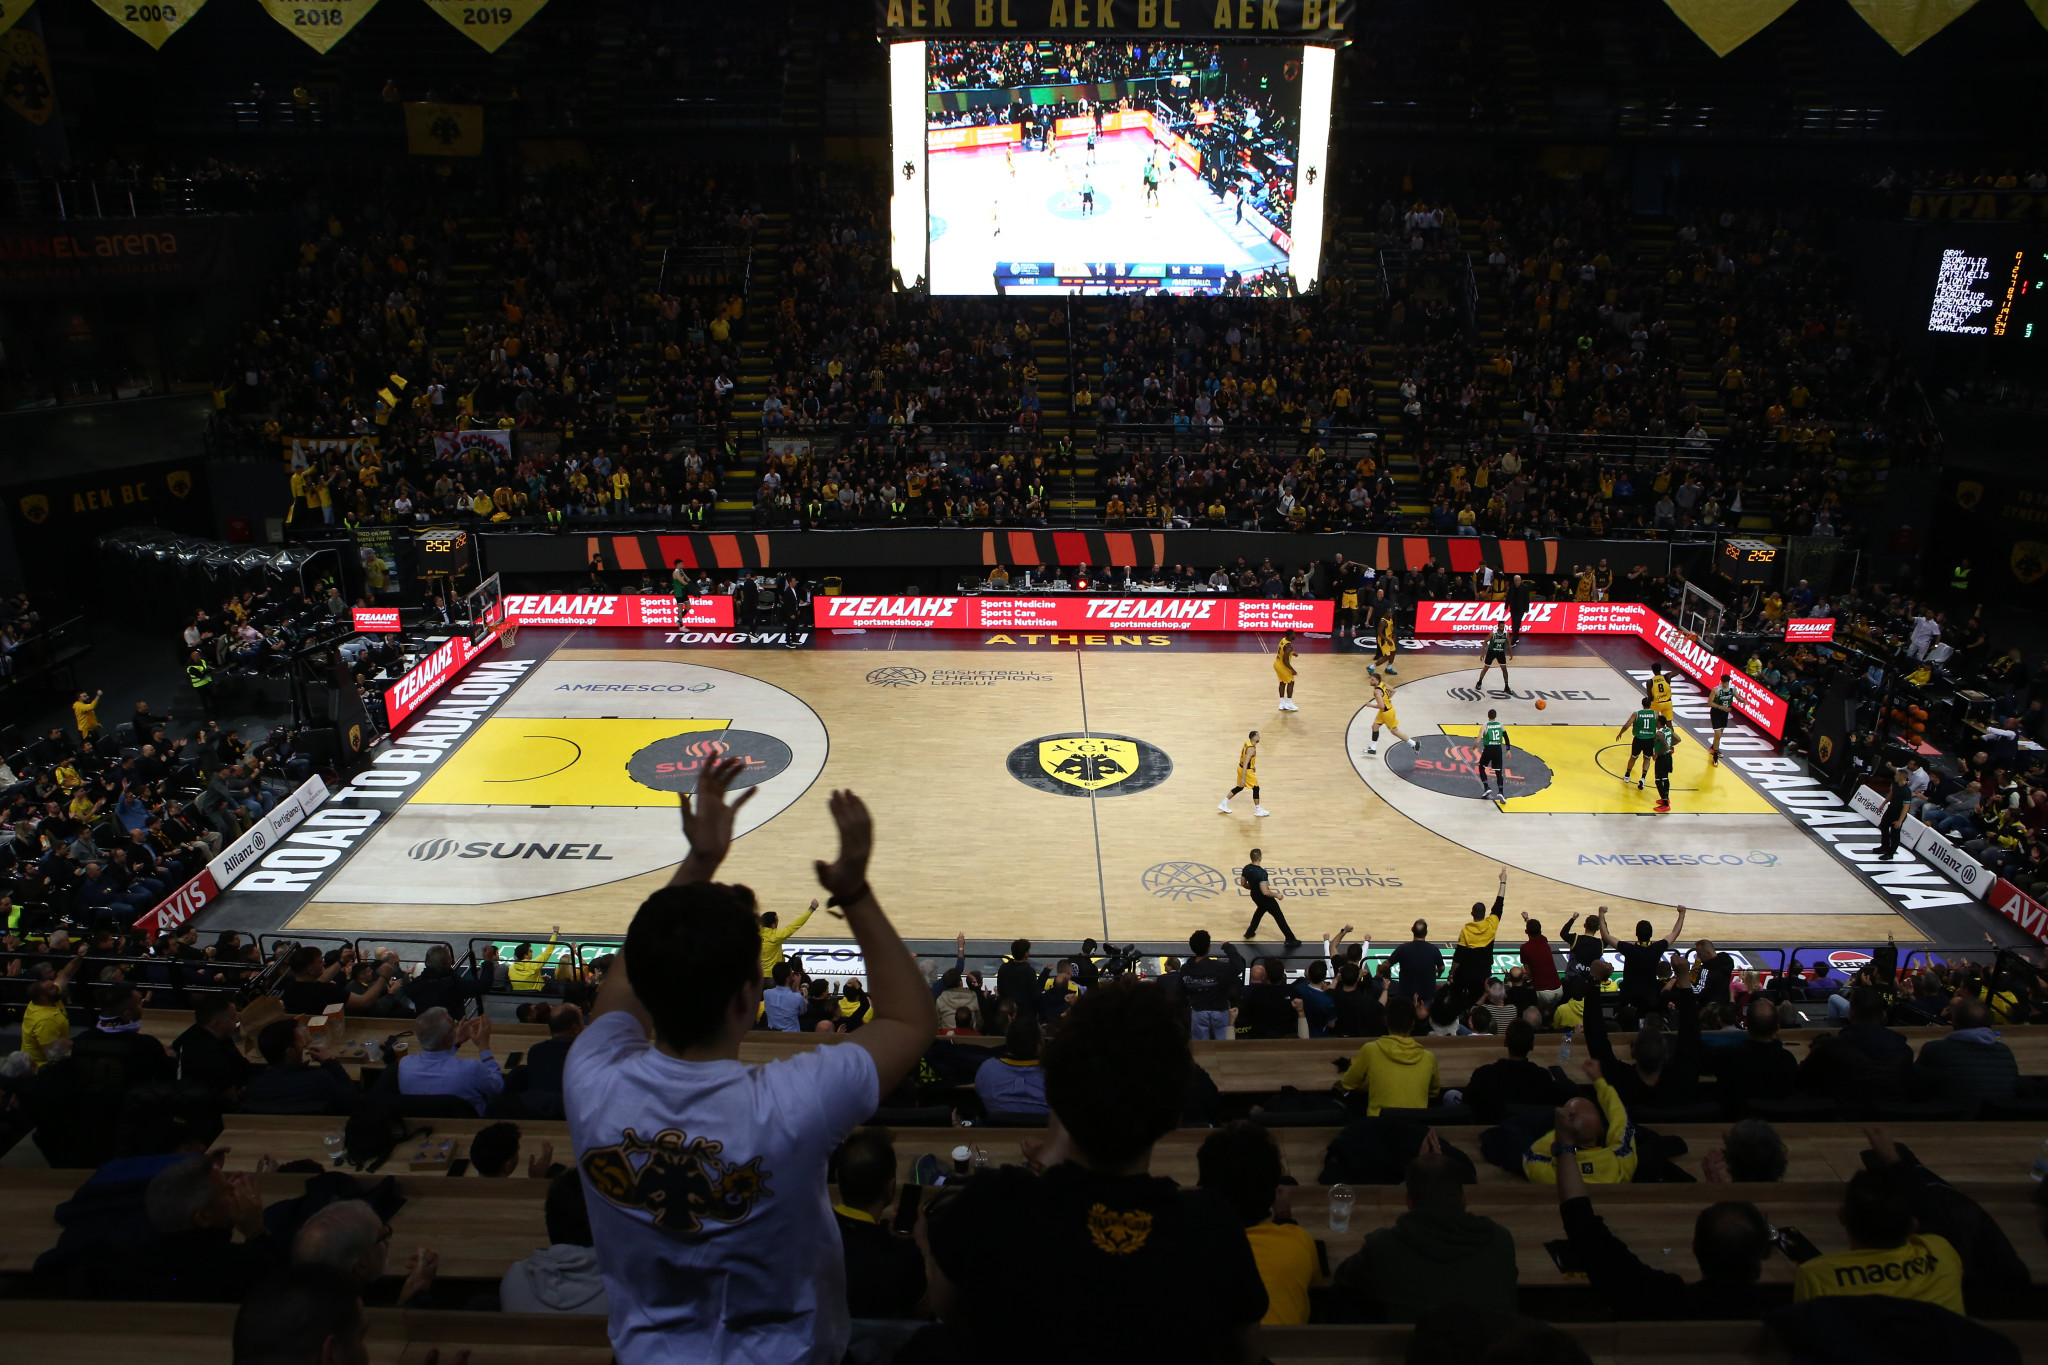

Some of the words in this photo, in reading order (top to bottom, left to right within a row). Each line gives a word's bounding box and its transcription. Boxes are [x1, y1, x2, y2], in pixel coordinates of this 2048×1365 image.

[125, 5, 177, 22] 2000
[294, 9, 343, 26] 2018
[463, 8, 512, 25] 2019
[886, 0, 952, 27] AEK
[974, 0, 1018, 28] BC
[1050, 0, 1116, 28] AEK
[1138, 0, 1181, 29] BC
[1213, 0, 1280, 30] AEK
[1301, 0, 1345, 30] BC
[0, 235, 91, 259] UNEL
[95, 232, 178, 257] arena
[1943, 249, 1964, 257] GRAY
[73, 489, 113, 512] AEK
[120, 481, 149, 504] BC
[426, 540, 451, 552] 2:52
[1747, 550, 1777, 562] 2:52
[640, 598, 671, 607] Sports
[672, 598, 714, 606] Micine
[828, 597, 959, 617] ΤΖΕΛΑΛΗΣ
[980, 600, 1012, 609] Sports
[1014, 600, 1056, 608] Medicine
[1238, 602, 1270, 611] Sports
[1271, 602, 1314, 611] Medicine
[640, 607, 671, 616] Sports
[980, 609, 1012, 618] Sports
[1014, 609, 1036, 617] Care
[1085, 600, 1217, 619] ΤΖΕΛΑΛΗΣ
[1238, 611, 1270, 620] Sports
[1271, 611, 1293, 620] Care
[1429, 602, 1558, 622] ΤΖΕΛΑΗΣ
[1579, 605, 1609, 615] Sports
[518, 617, 597, 625] sportsmedshop.gr
[641, 616, 672, 625] Sports
[853, 618, 934, 627] sportsmedshop.gr
[980, 618, 1012, 627] Sports
[1014, 618, 1058, 626] Nutrition
[1109, 620, 1192, 630] sportsmedshop.gr
[1238, 620, 1270, 629] Sports
[1271, 620, 1314, 629] Nutrition
[1577, 614, 1608, 624] Sports
[1610, 614, 1631, 622] Care
[1576, 623, 1607, 633] Sports
[984, 634, 1172, 647] ATHENS
[1663, 647, 1703, 679] sportsmedshop.gr
[408, 673, 446, 710] sportsmedshop.gr
[554, 684, 686, 692] AMERESCO
[1657, 683, 1664, 693] 8
[1729, 670, 1748, 688] Sports
[1748, 683, 1774, 706] Medicine
[1487, 689, 1611, 701] SUNEL
[1746, 693, 1760, 708] Care
[373, 659, 537, 764] BADALONA
[1746, 704, 1771, 728] Nutrition
[1643, 718, 1650, 729] 11
[1492, 729, 1500, 740] 12
[335, 770, 422, 802] TO
[1729, 756, 1975, 910] BADALONA
[232, 809, 381, 892] ROAD
[457, 841, 614, 861] SUNEL
[223, 843, 255, 875] Allianz
[1577, 854, 1744, 866] AMERESCO
[1928, 841, 1962, 873] Allianz
[1232, 867, 1380, 876] BSKETBALL
[1234, 877, 1403, 887] CAMPIONS
[157, 880, 207, 929] AVIS
